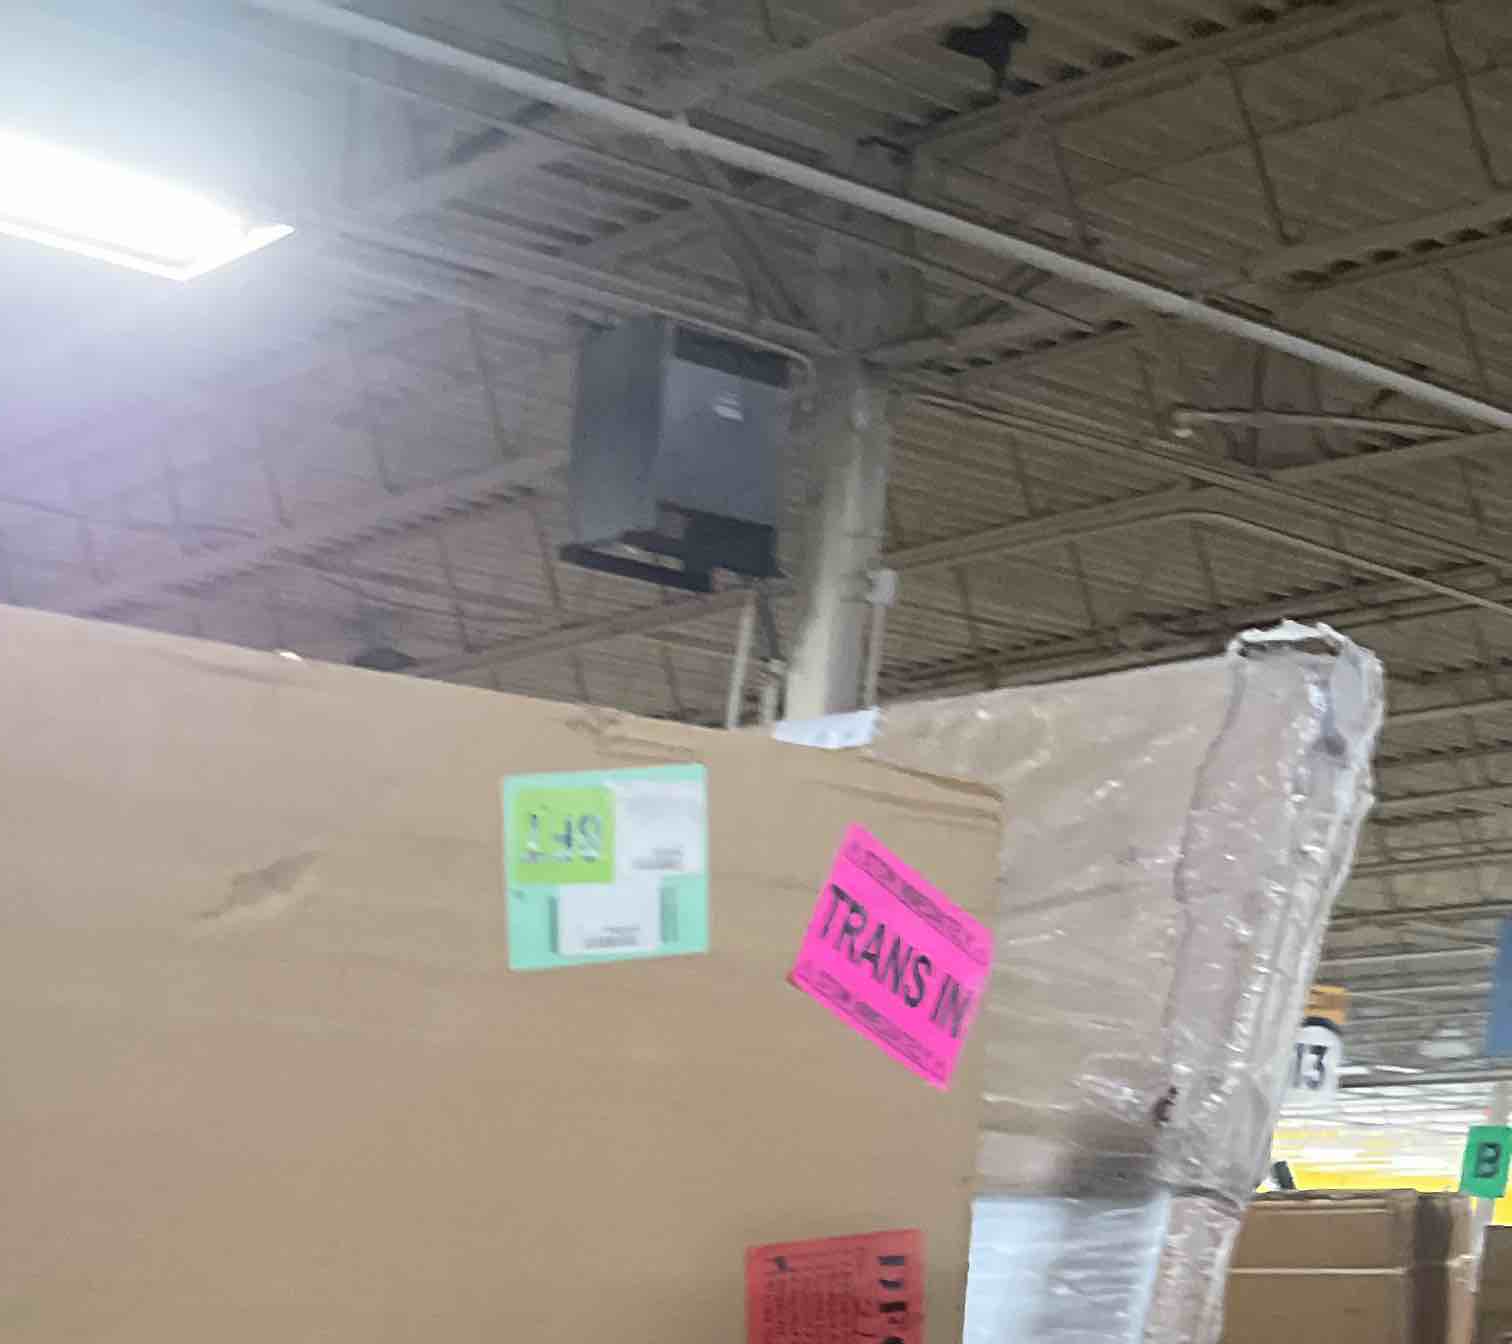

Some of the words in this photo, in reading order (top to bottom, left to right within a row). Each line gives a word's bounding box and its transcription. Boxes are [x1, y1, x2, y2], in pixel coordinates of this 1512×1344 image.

[818, 883, 933, 1009] TRANS
[929, 973, 976, 1040] IN
[1475, 1141, 1502, 1179] B
